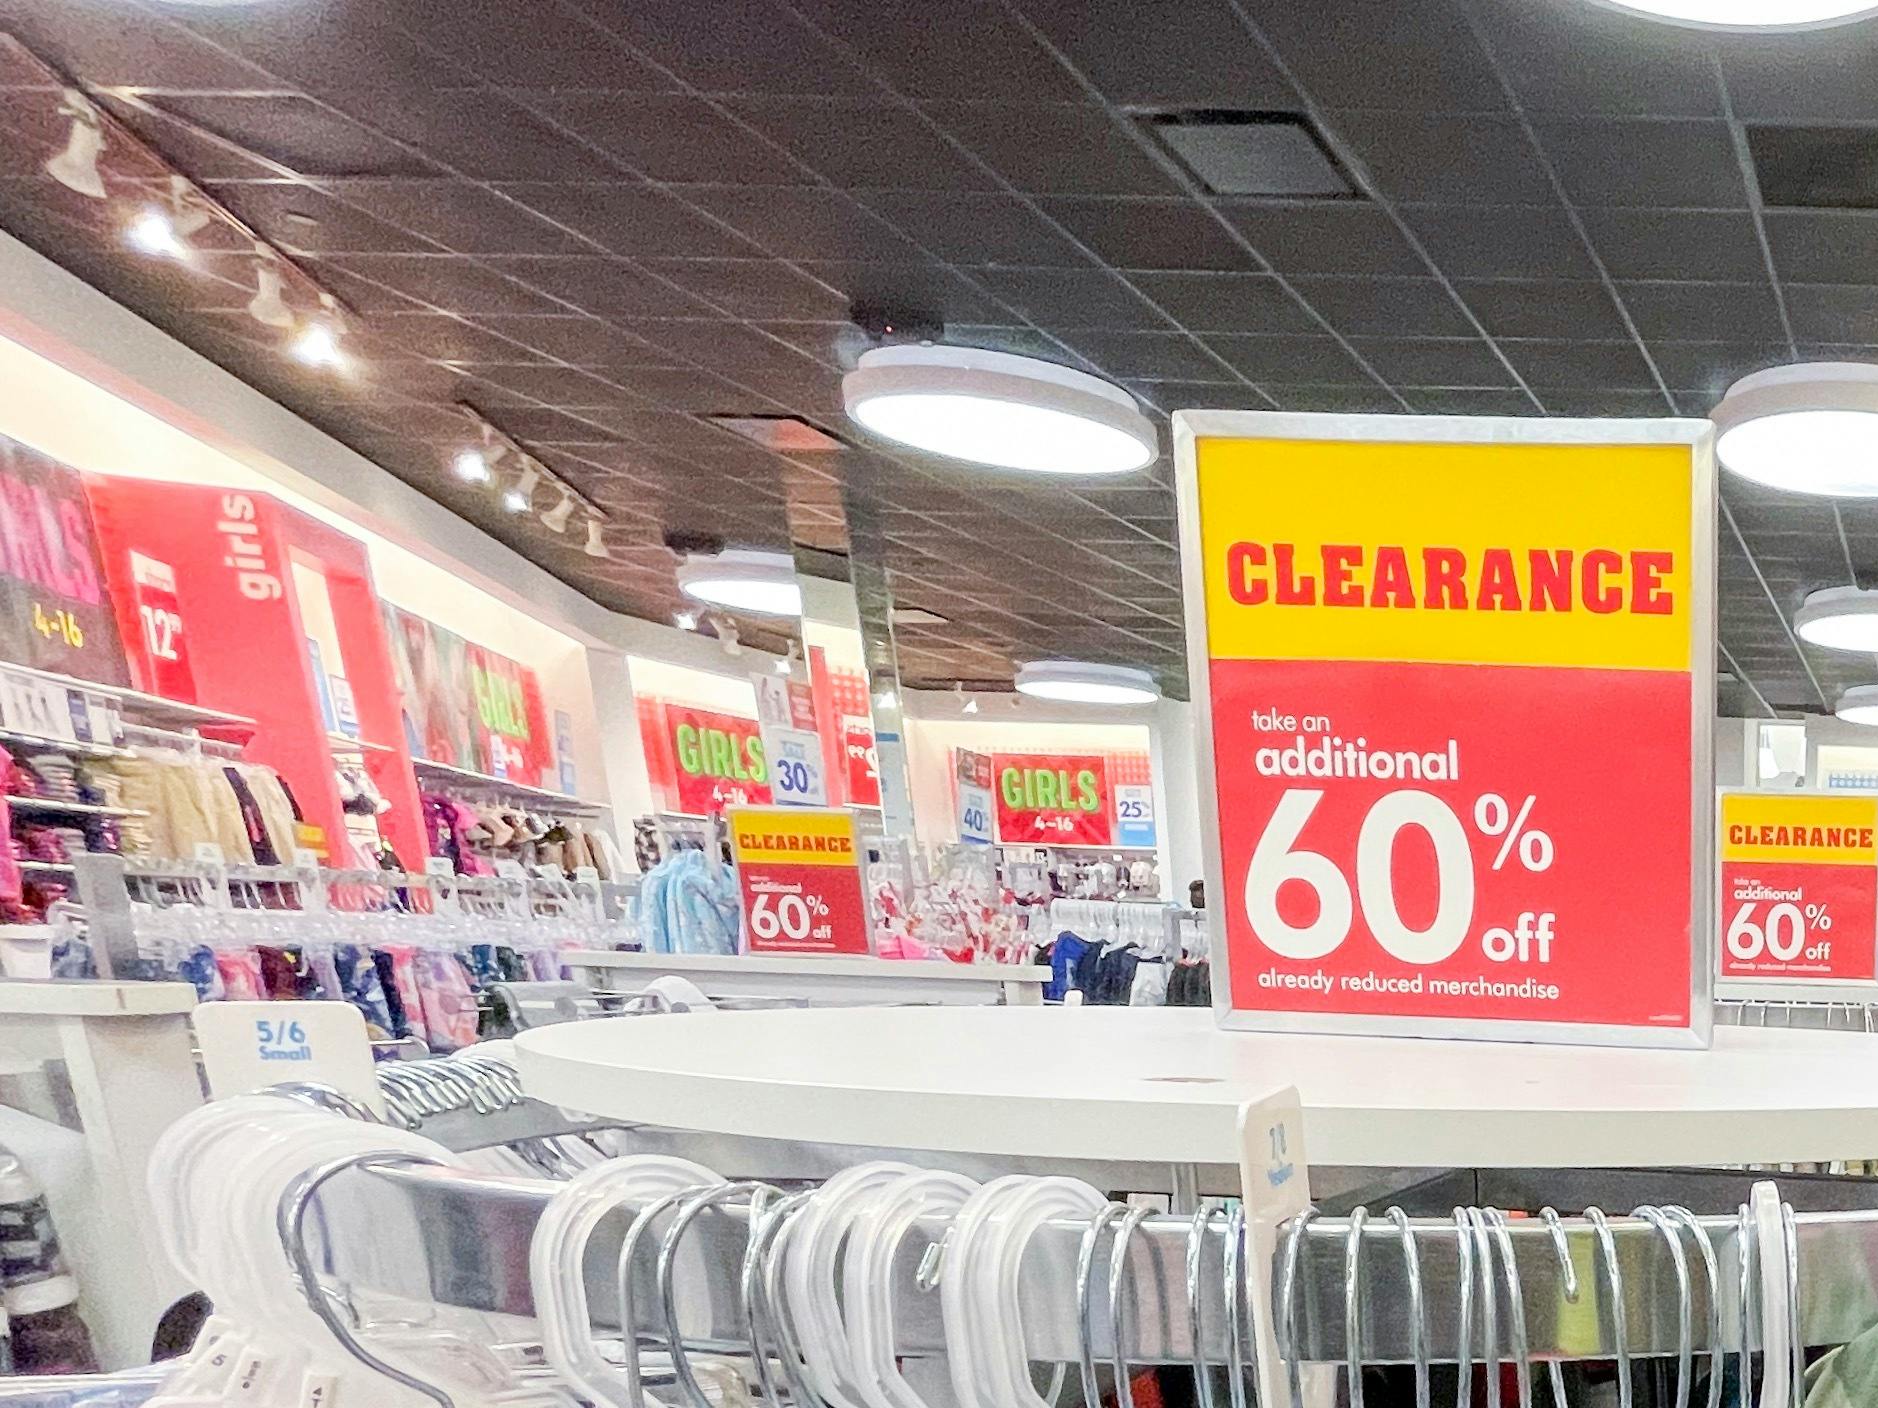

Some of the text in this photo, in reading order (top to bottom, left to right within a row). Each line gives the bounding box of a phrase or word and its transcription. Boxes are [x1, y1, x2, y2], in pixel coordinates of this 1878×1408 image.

[217, 495, 281, 600] girls
[1227, 541, 1674, 615] CLEARANCE
[32, 602, 84, 648] 4-16
[1252, 707, 1331, 732] take an
[677, 724, 769, 784] GIRLS
[1255, 735, 1459, 781] additional
[777, 760, 808, 793] 30
[1002, 767, 1098, 811] GIRLS
[1034, 815, 1074, 832] 4-16
[1729, 825, 1873, 848] CLEARANCE
[738, 833, 852, 853] CLEARANCE
[1244, 788, 1555, 965] 60%
[1734, 885, 1803, 901] additional
[751, 894, 829, 940] 60%
[812, 925, 832, 939] off
[1727, 902, 1832, 961] 60%
[1481, 912, 1556, 963] off
[1805, 942, 1831, 960] off
[1257, 967, 1560, 999] already reduced merchandise
[256, 1020, 306, 1045] 5/6
[258, 1045, 313, 1061] Small
